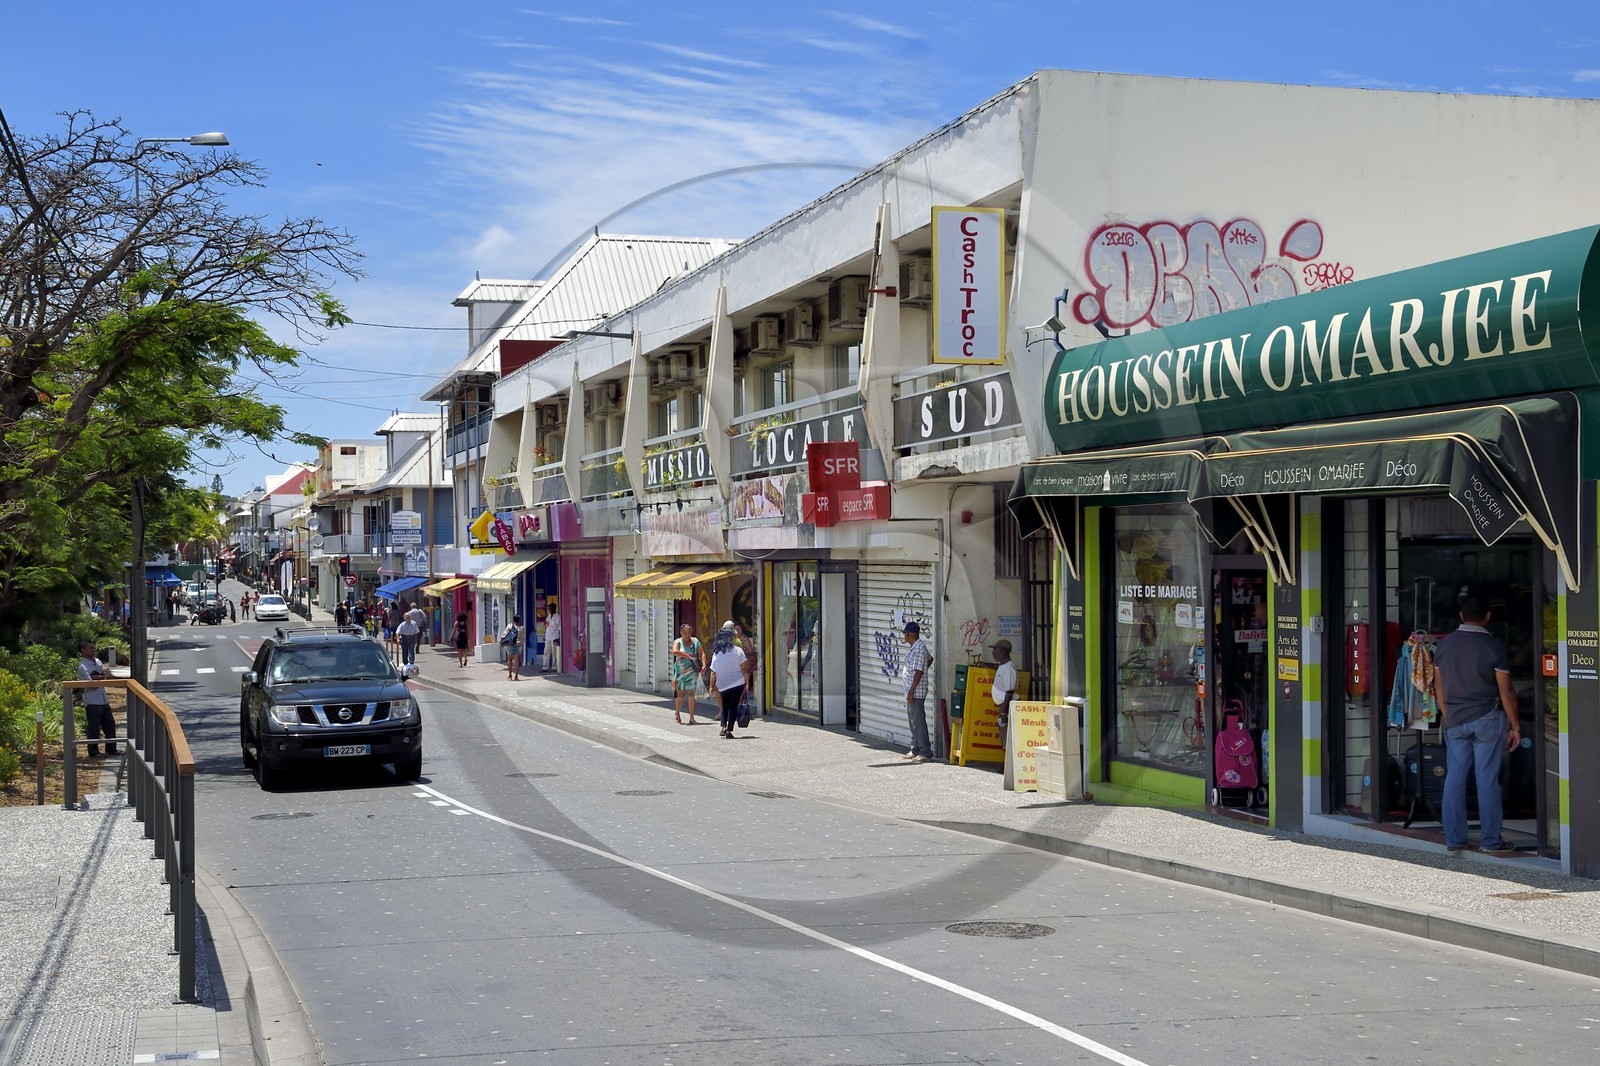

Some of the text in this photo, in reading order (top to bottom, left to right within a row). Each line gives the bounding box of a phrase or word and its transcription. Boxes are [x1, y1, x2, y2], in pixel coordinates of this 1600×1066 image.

[960, 216, 978, 356] Cash Troc
[1058, 333, 1252, 425] HOUSSEIN
[1258, 270, 1552, 392] OMARJEE
[921, 380, 1004, 438] SUD
[824, 458, 859, 474] SFR
[1220, 460, 1417, 488] Déco HOUSSEIN OMARJEE Déco
[1078, 472, 1128, 486] maison vivre
[818, 496, 828, 512] SFR
[842, 494, 874, 516] espace SFR
[1471, 474, 1504, 520] HOUSSEIN
[1464, 490, 1490, 529] OMARJEE
[498, 523, 512, 551] TABAC
[783, 571, 816, 597] NEXT
[1120, 585, 1197, 599] LISTE DE MARIAGE
[1278, 635, 1298, 645] Arts de
[1278, 647, 1298, 657] la table
[1572, 653, 1595, 666] Déco
